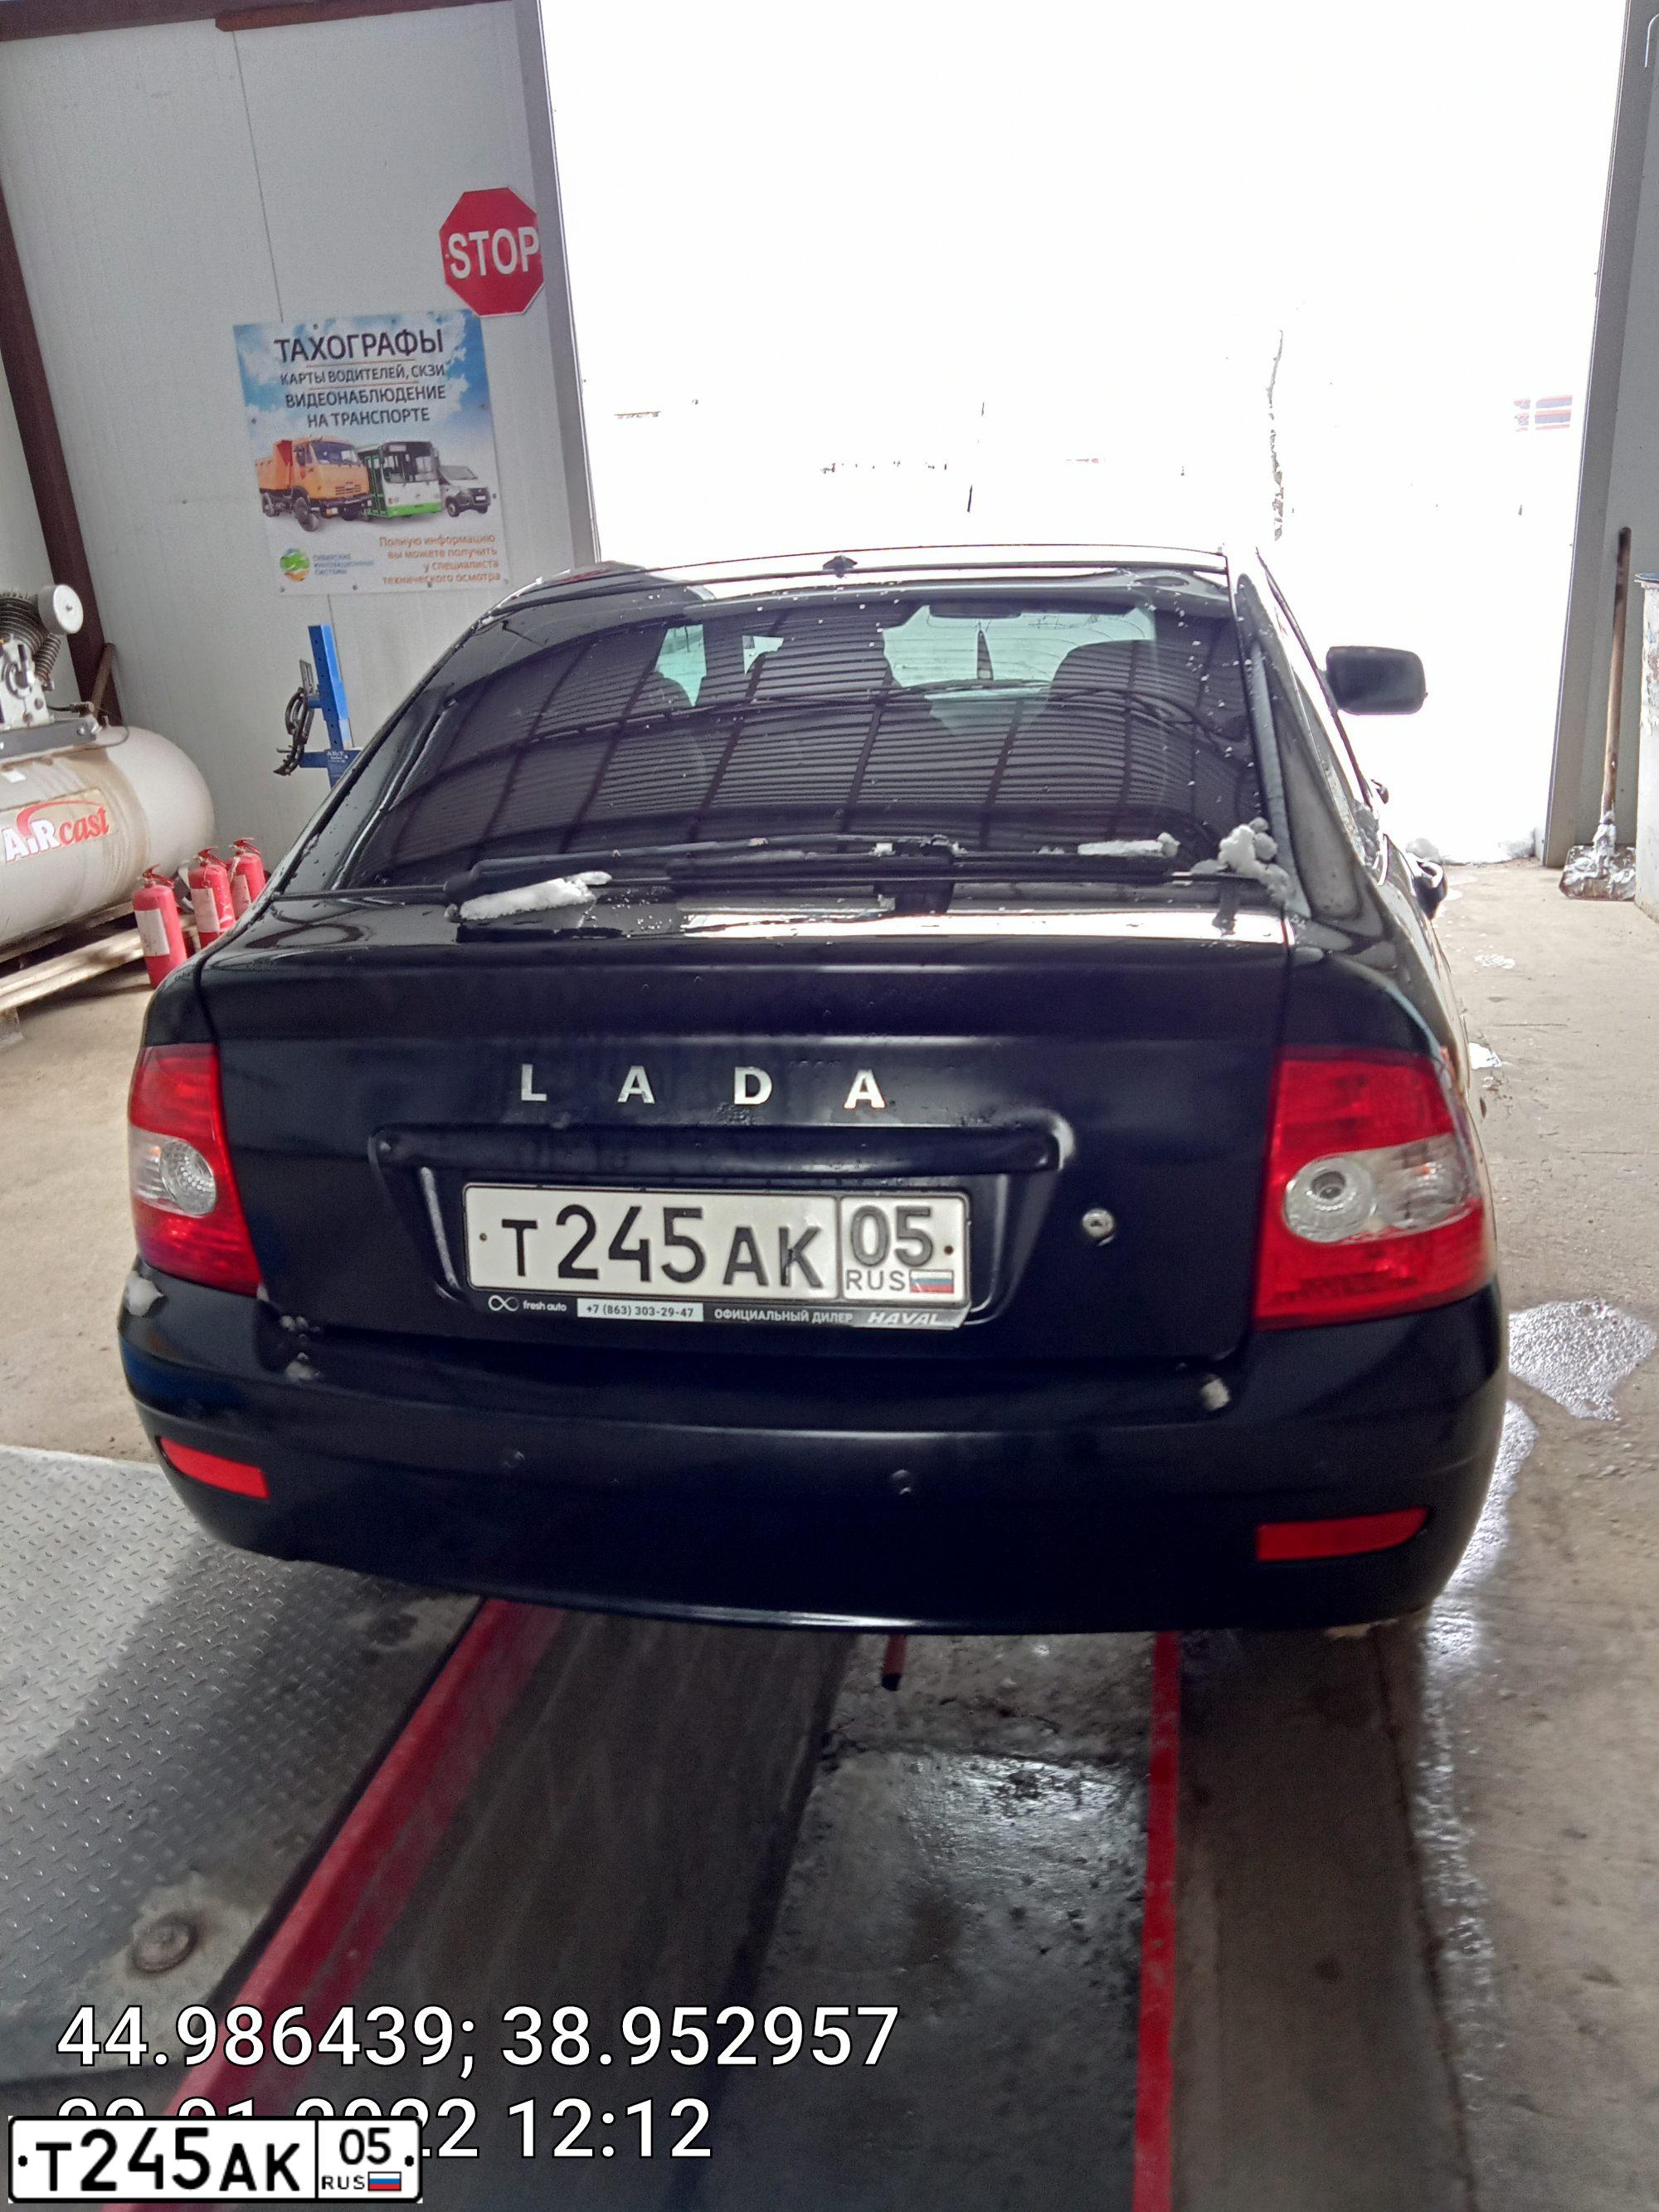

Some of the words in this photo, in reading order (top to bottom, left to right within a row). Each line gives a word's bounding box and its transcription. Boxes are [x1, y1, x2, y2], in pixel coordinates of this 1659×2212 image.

[448, 226, 540, 280] STOP
[274, 329, 444, 363] ТАХОГРАФЫ
[280, 372, 326, 386] КАРТЫ
[328, 363, 409, 383] ВОДИТЕЛЕЙ,
[411, 364, 445, 378] СКЗИ
[285, 385, 446, 409] ВИДЕОНАБЛЮДЕНИЕ
[308, 414, 328, 428] НА
[331, 407, 431, 427] ТРАНСПОРТЕ
[379, 537, 422, 548] Полную
[424, 534, 496, 548] информацию
[387, 551, 402, 559] вы
[405, 548, 445, 559] можете
[448, 547, 498, 558] получить
[432, 559, 499, 571] специалиста
[383, 574, 453, 584] технического
[456, 572, 501, 583] осмотра
[521, 1064, 886, 1110] LADA
[851, 1206, 933, 1268] 05
[846, 1269, 906, 1291] RUS
[523, 1300, 545, 1311] fresh
[547, 1303, 567, 1312] auto
[586, 1303, 599, 1314] +7
[602, 1303, 632, 1317] (863)
[635, 1306, 694, 1318] 303-29-47
[714, 1308, 810, 1323] ОФИЦИАЛЬНЫЙ
[812, 1311, 854, 1324] ДИЛЕР
[868, 1311, 942, 1325] HAVAL
